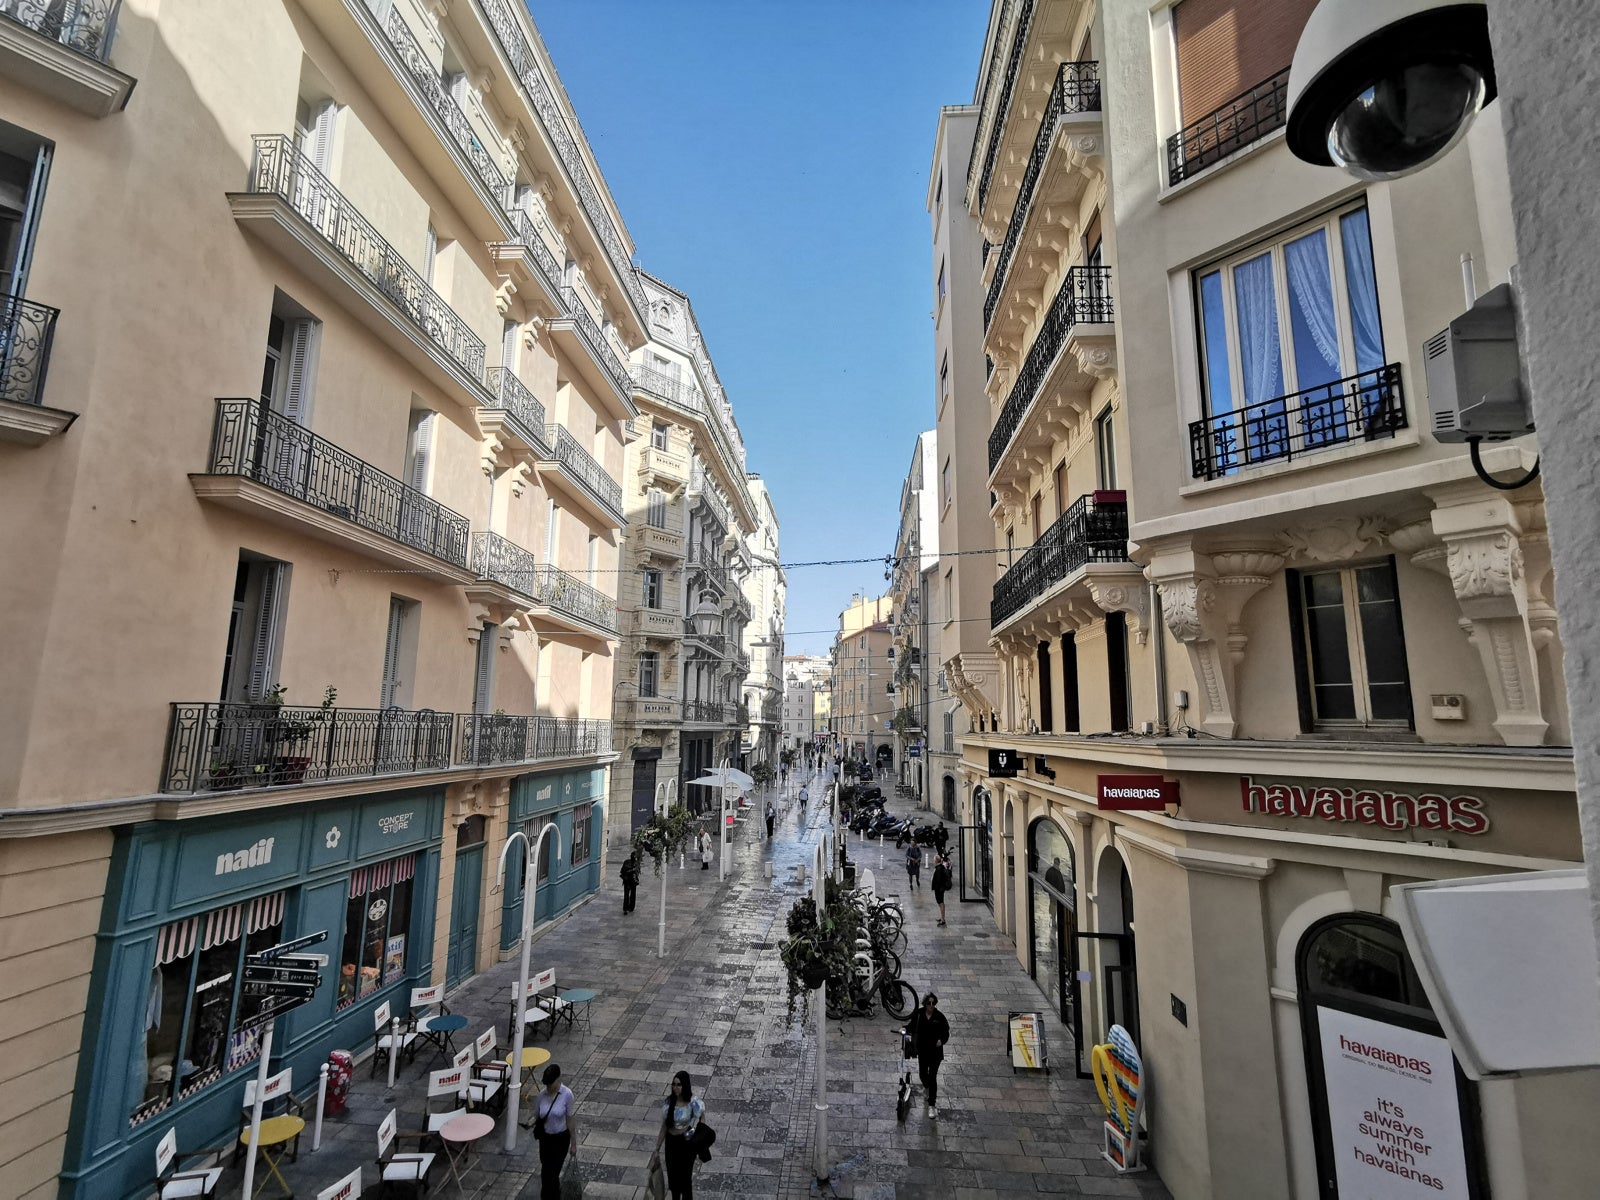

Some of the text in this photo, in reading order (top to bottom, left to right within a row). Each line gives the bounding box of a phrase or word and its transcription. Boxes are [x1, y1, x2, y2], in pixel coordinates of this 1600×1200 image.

[1103, 786, 1160, 799] havaianas
[1239, 776, 1489, 834] havaianas
[378, 812, 414, 827] CONCEPT
[215, 837, 275, 875] natif
[1340, 1034, 1432, 1075] havaianas
[438, 1072, 461, 1085] natif
[1358, 1122, 1432, 1156] summer
[1363, 1110, 1424, 1140] always
[1353, 1146, 1444, 1191] havaianas
[1376, 1143, 1415, 1166] with
